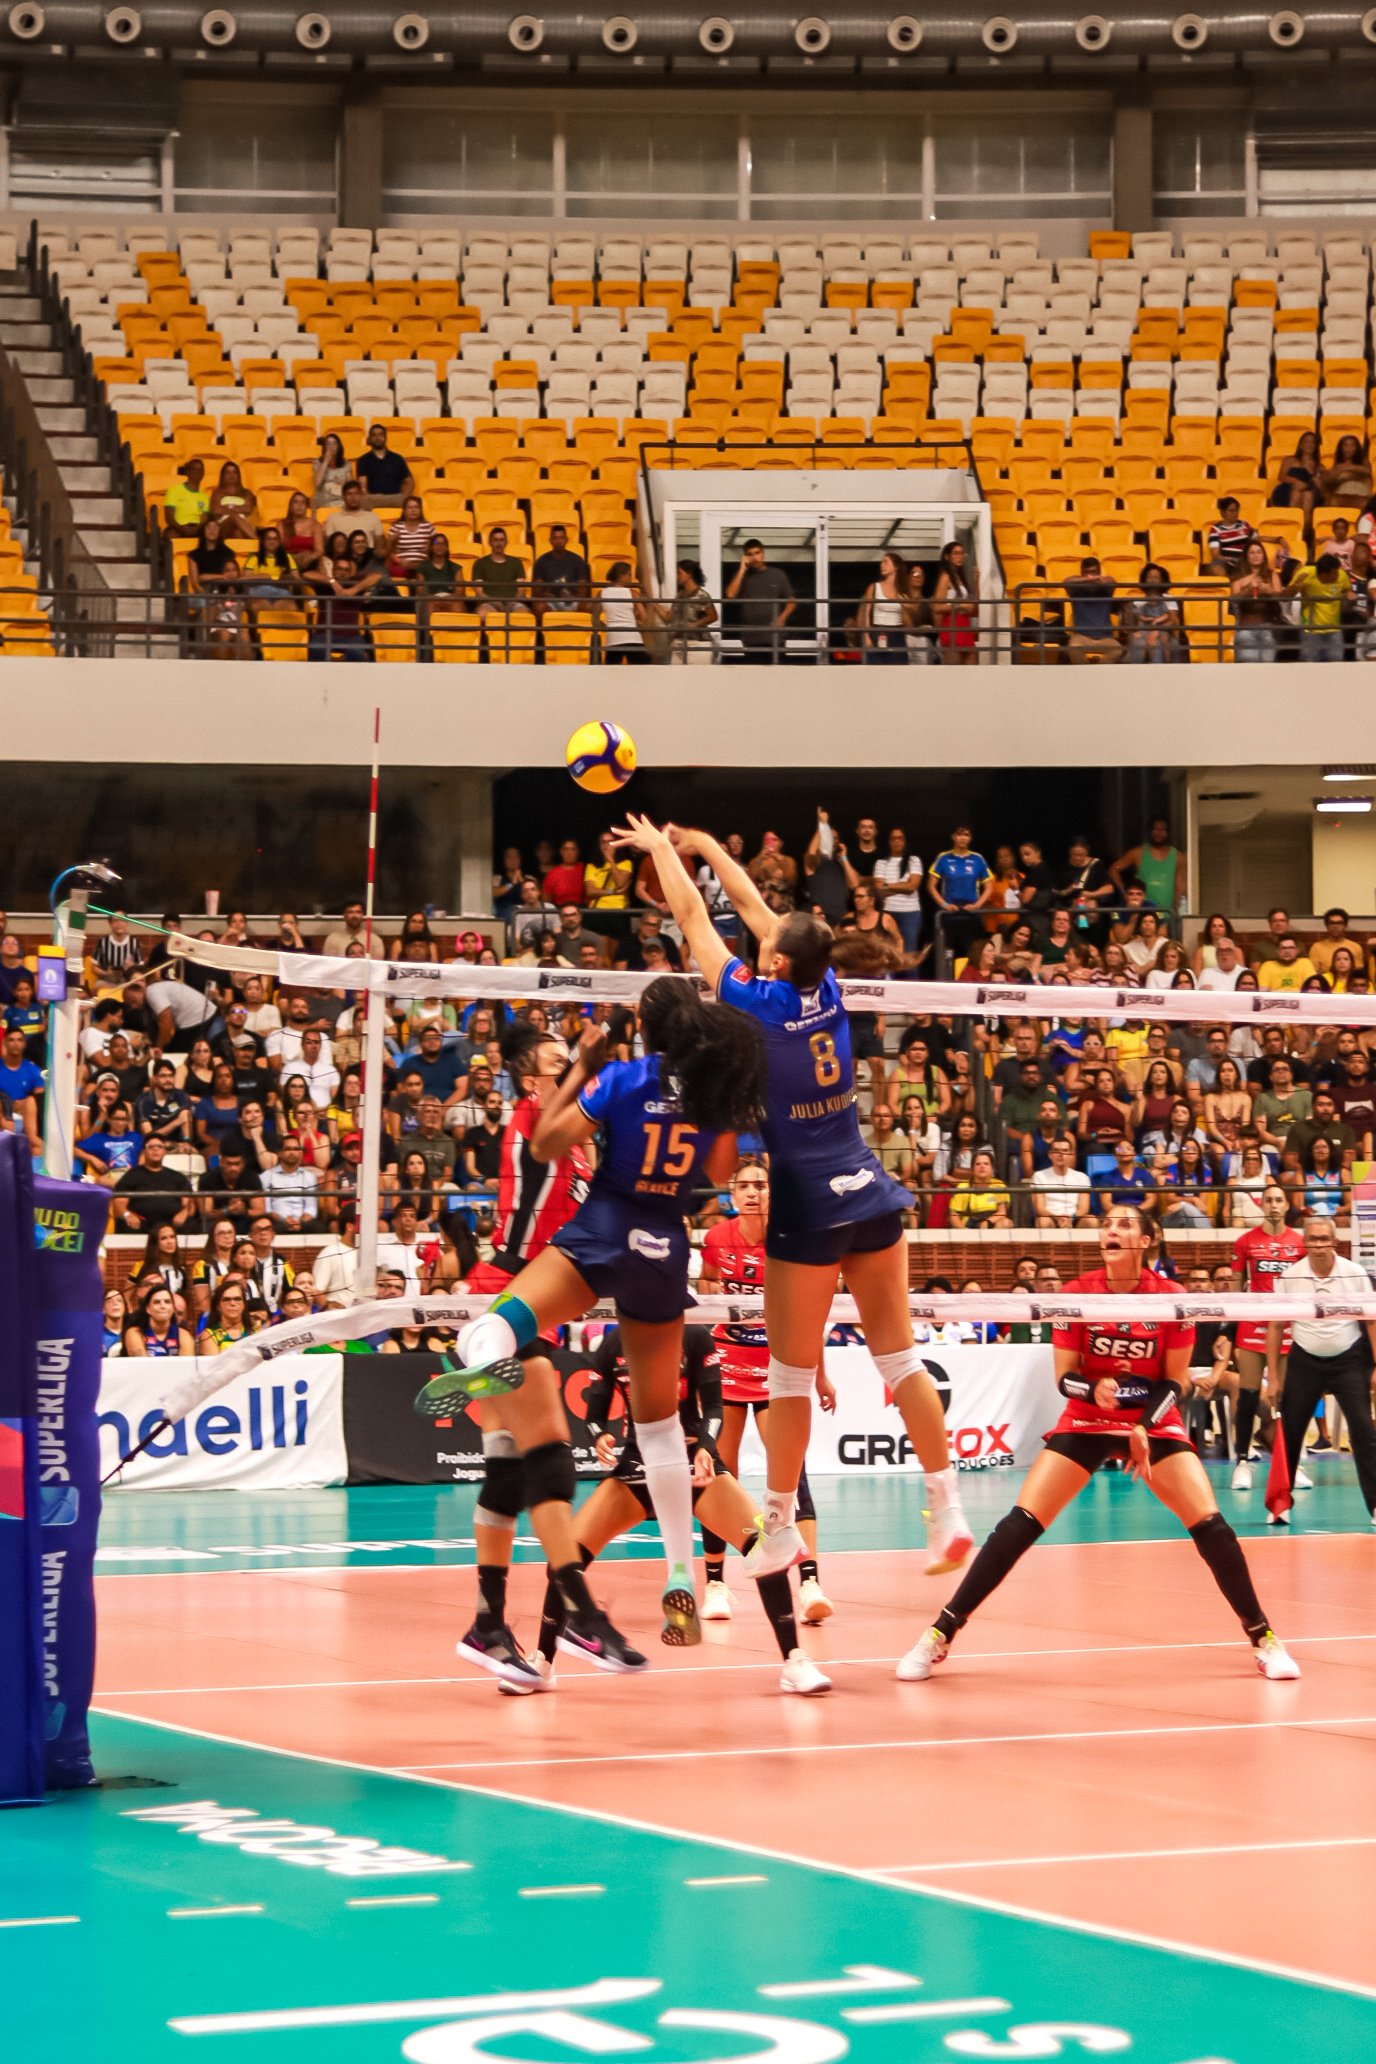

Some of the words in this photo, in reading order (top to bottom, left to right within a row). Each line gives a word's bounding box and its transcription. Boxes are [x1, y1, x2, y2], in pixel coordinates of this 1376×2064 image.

[398, 968, 441, 980] SUPERLIGA
[551, 976, 593, 988] SUPERLIGA
[845, 985, 885, 997] SUPERLIGA
[988, 991, 1027, 1002] SUPERLIGA
[808, 1032, 841, 1087] 8
[789, 1100, 825, 1119] JULIA
[641, 1123, 699, 1177] 15
[426, 1309, 470, 1322] SUPERLIGA
[1093, 1337, 1154, 1360] SESI
[118, 1800, 474, 1877] RECOMA
